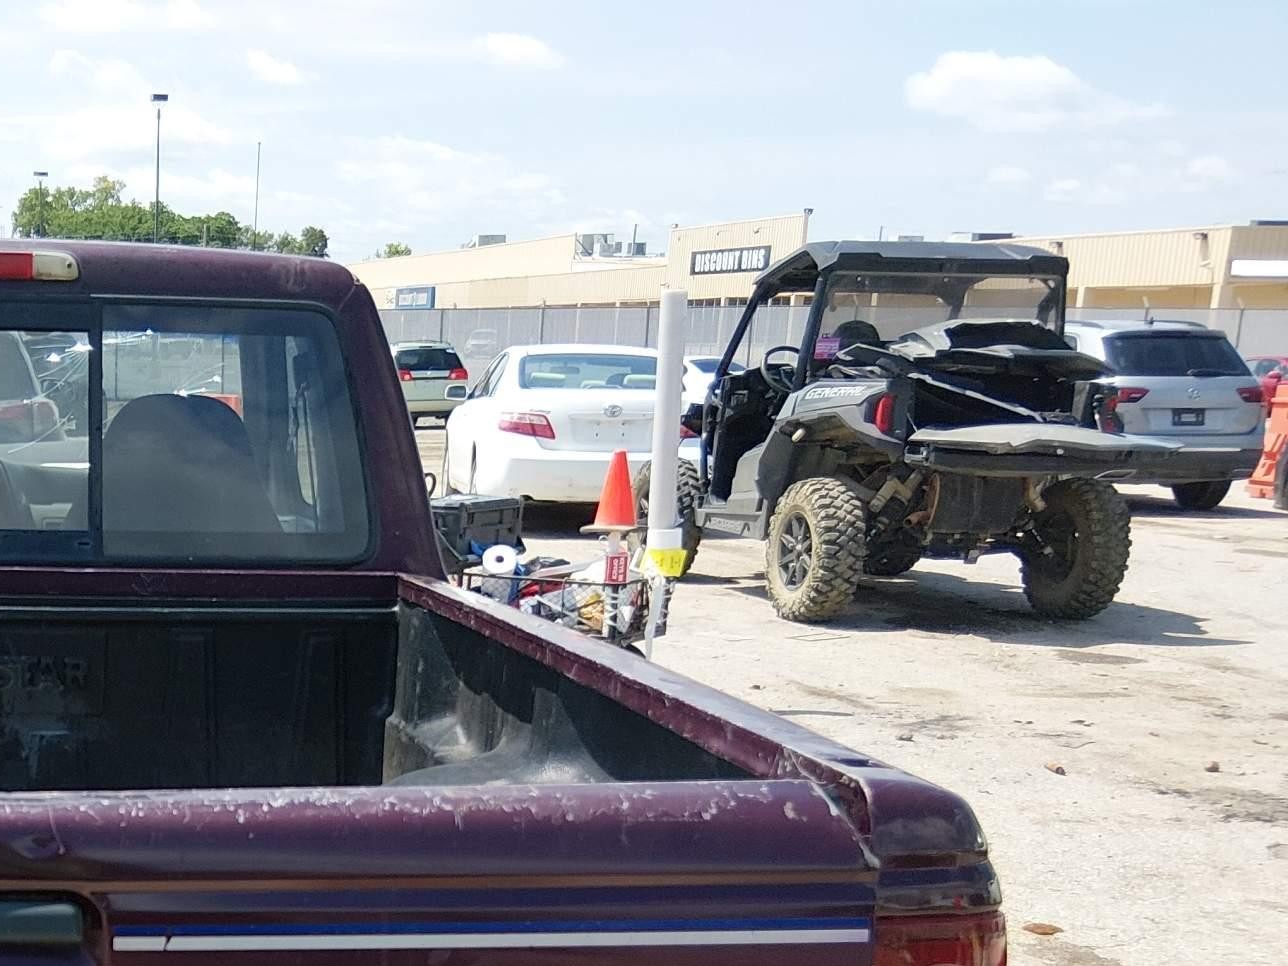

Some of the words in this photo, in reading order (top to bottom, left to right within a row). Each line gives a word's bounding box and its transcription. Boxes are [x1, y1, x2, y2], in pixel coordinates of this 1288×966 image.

[694, 250, 741, 273] DISCOUNT
[741, 248, 765, 270] BINS
[805, 386, 867, 400] GENERAL
